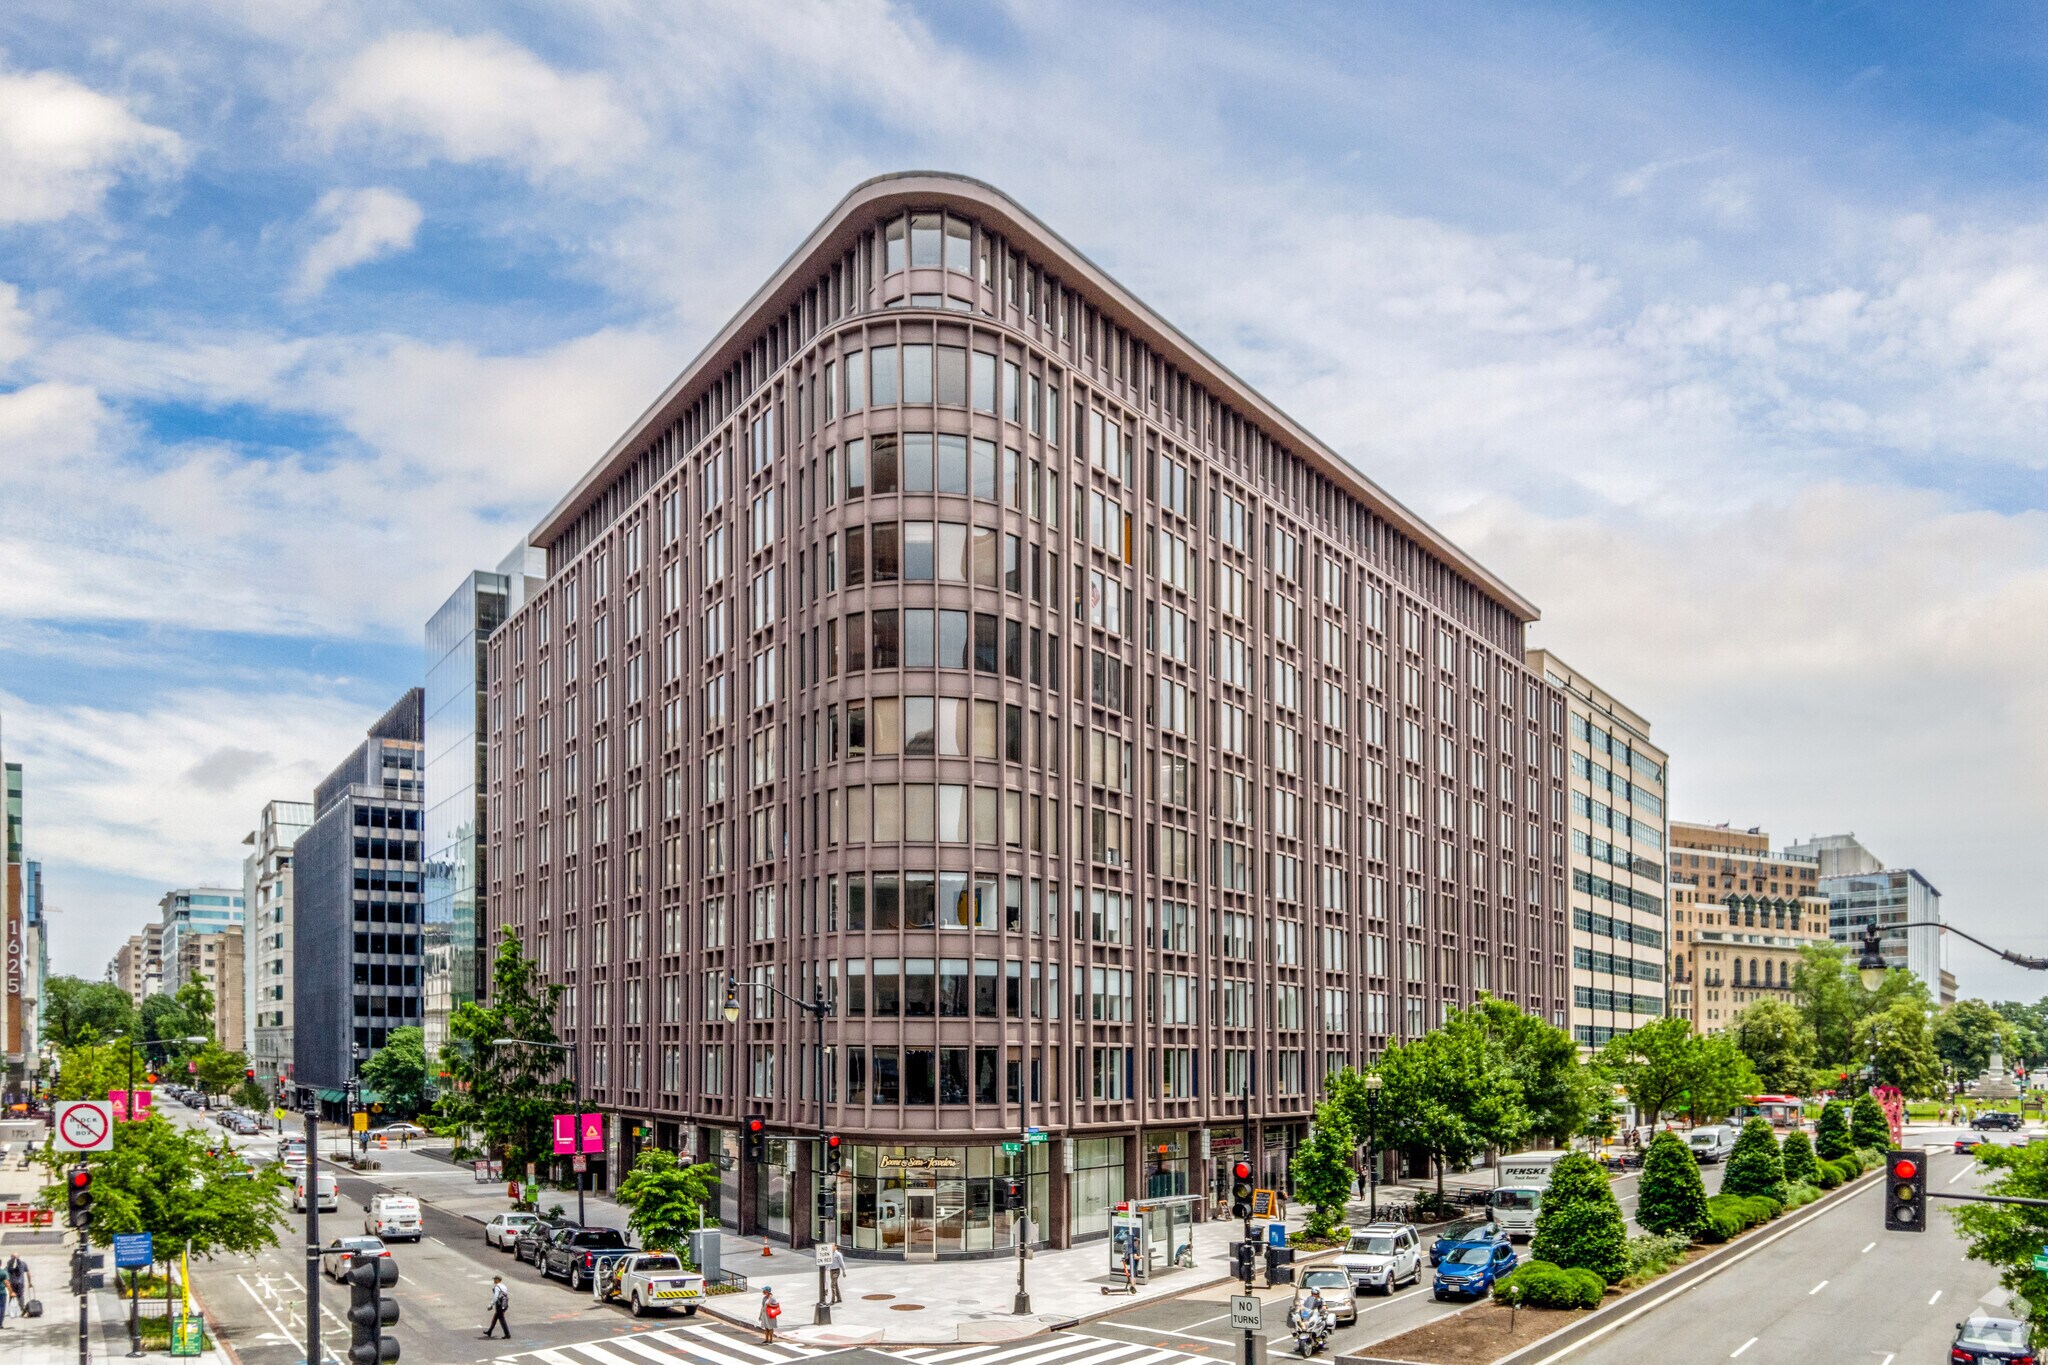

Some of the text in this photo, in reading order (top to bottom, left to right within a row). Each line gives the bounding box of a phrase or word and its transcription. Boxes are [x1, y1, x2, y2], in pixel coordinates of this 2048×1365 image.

[8, 920, 20, 993] 1625
[556, 1119, 573, 1140] L
[880, 1155, 901, 1168] Boone
[908, 1157, 924, 1167] Sons
[924, 1157, 957, 1169] Jewelers
[1505, 1167, 1548, 1175] PENSKE
[1238, 1301, 1253, 1311] NO
[1233, 1314, 1259, 1325] TURNS
